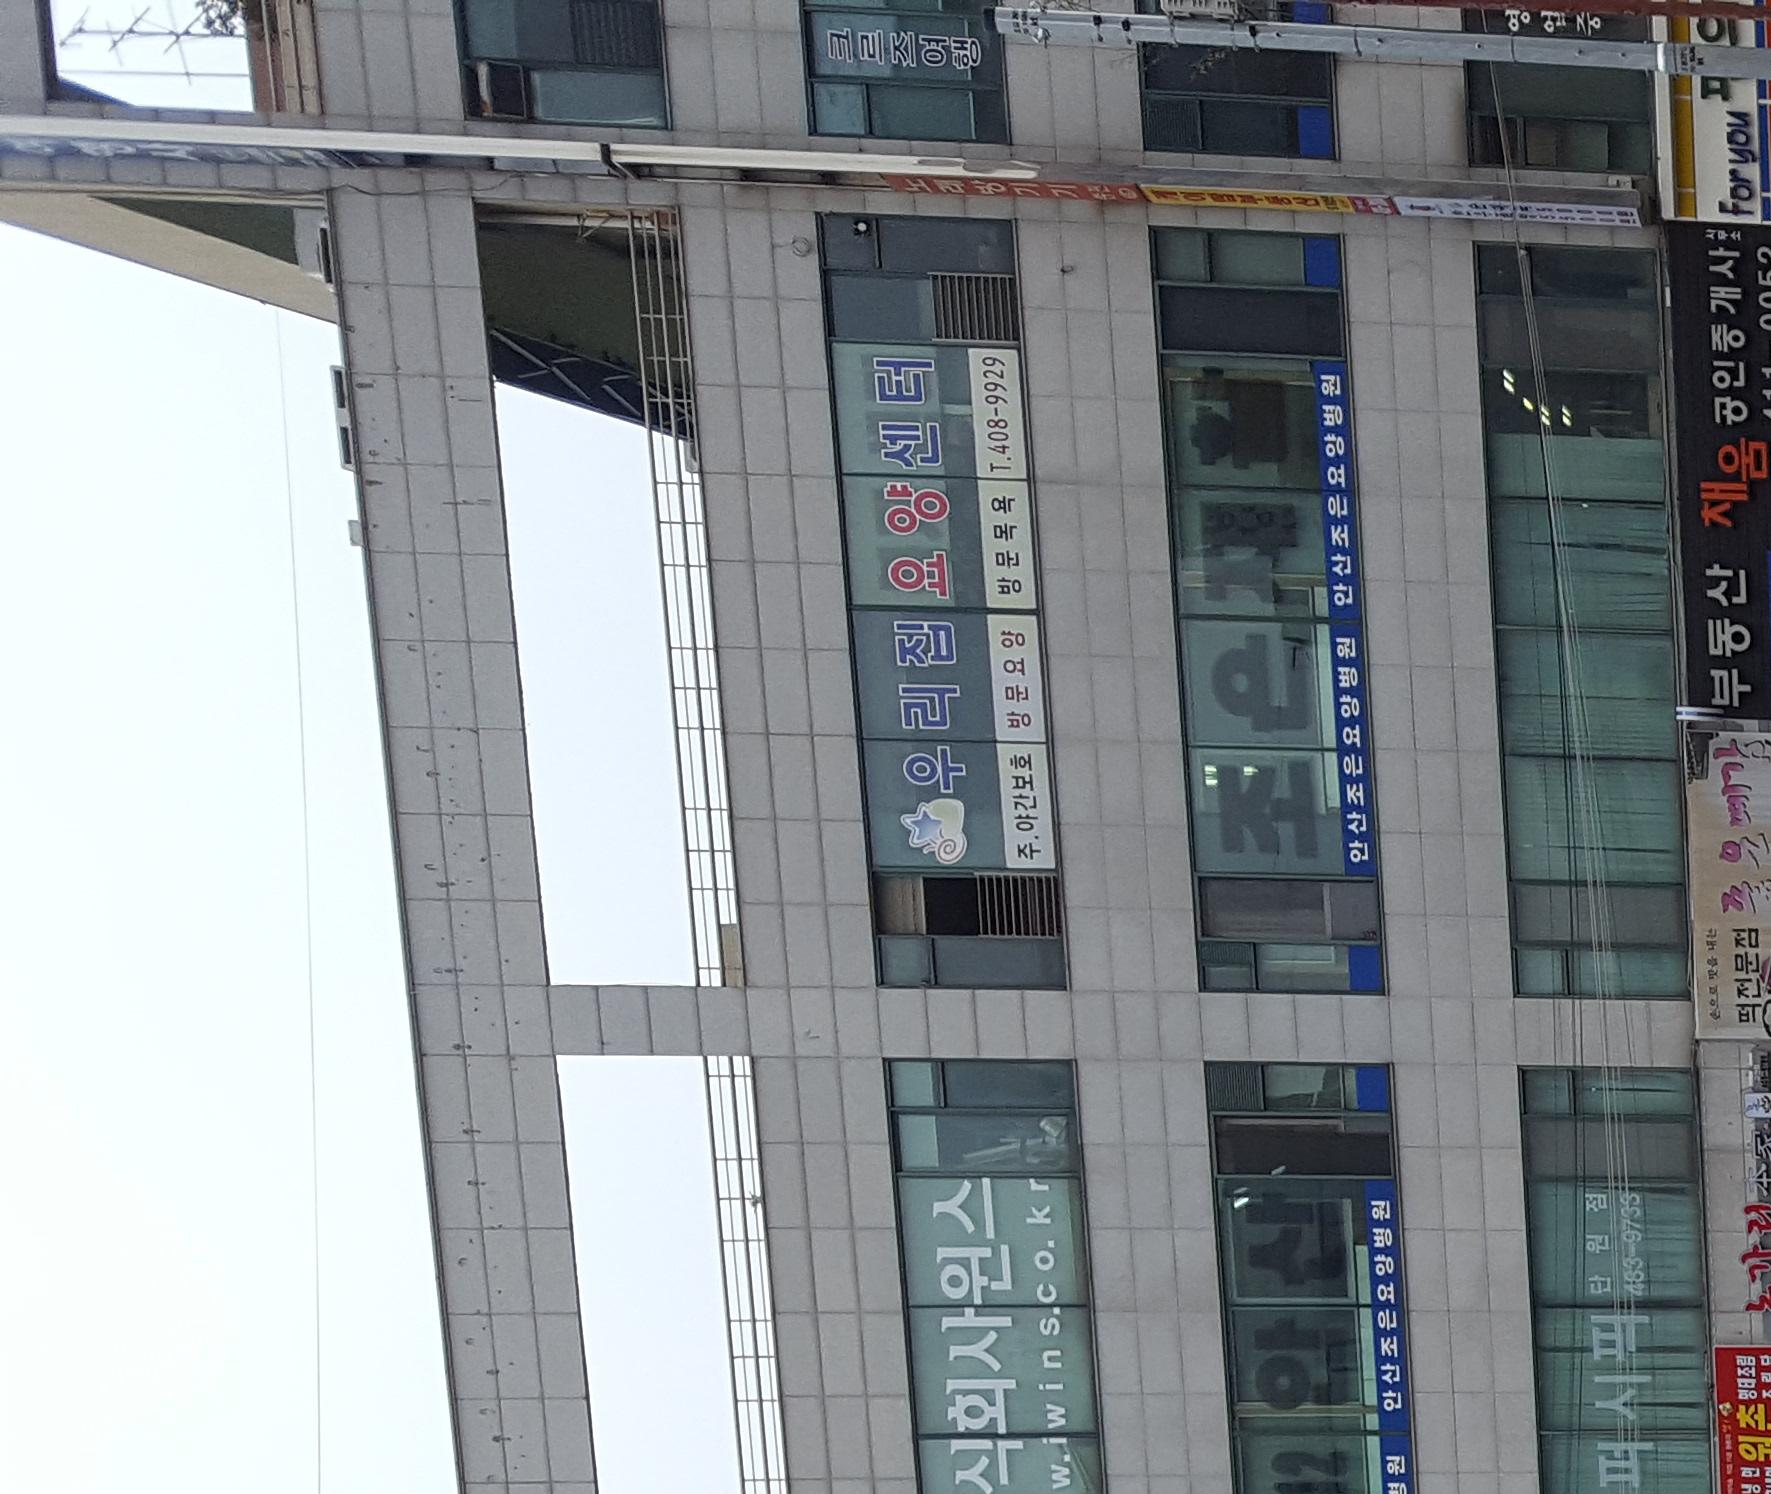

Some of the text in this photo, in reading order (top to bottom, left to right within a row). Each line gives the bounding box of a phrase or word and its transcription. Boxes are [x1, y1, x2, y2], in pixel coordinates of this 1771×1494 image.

[1708, 246, 1748, 426] 공인중개사
[1318, 372, 1354, 608] 안산조은요양병원
[1699, 437, 1769, 528] 채움
[1704, 563, 1752, 708] 부동산
[1334, 635, 1370, 864] 안산조은요양병원
[1371, 1198, 1402, 1412] 안산조은요양병원
